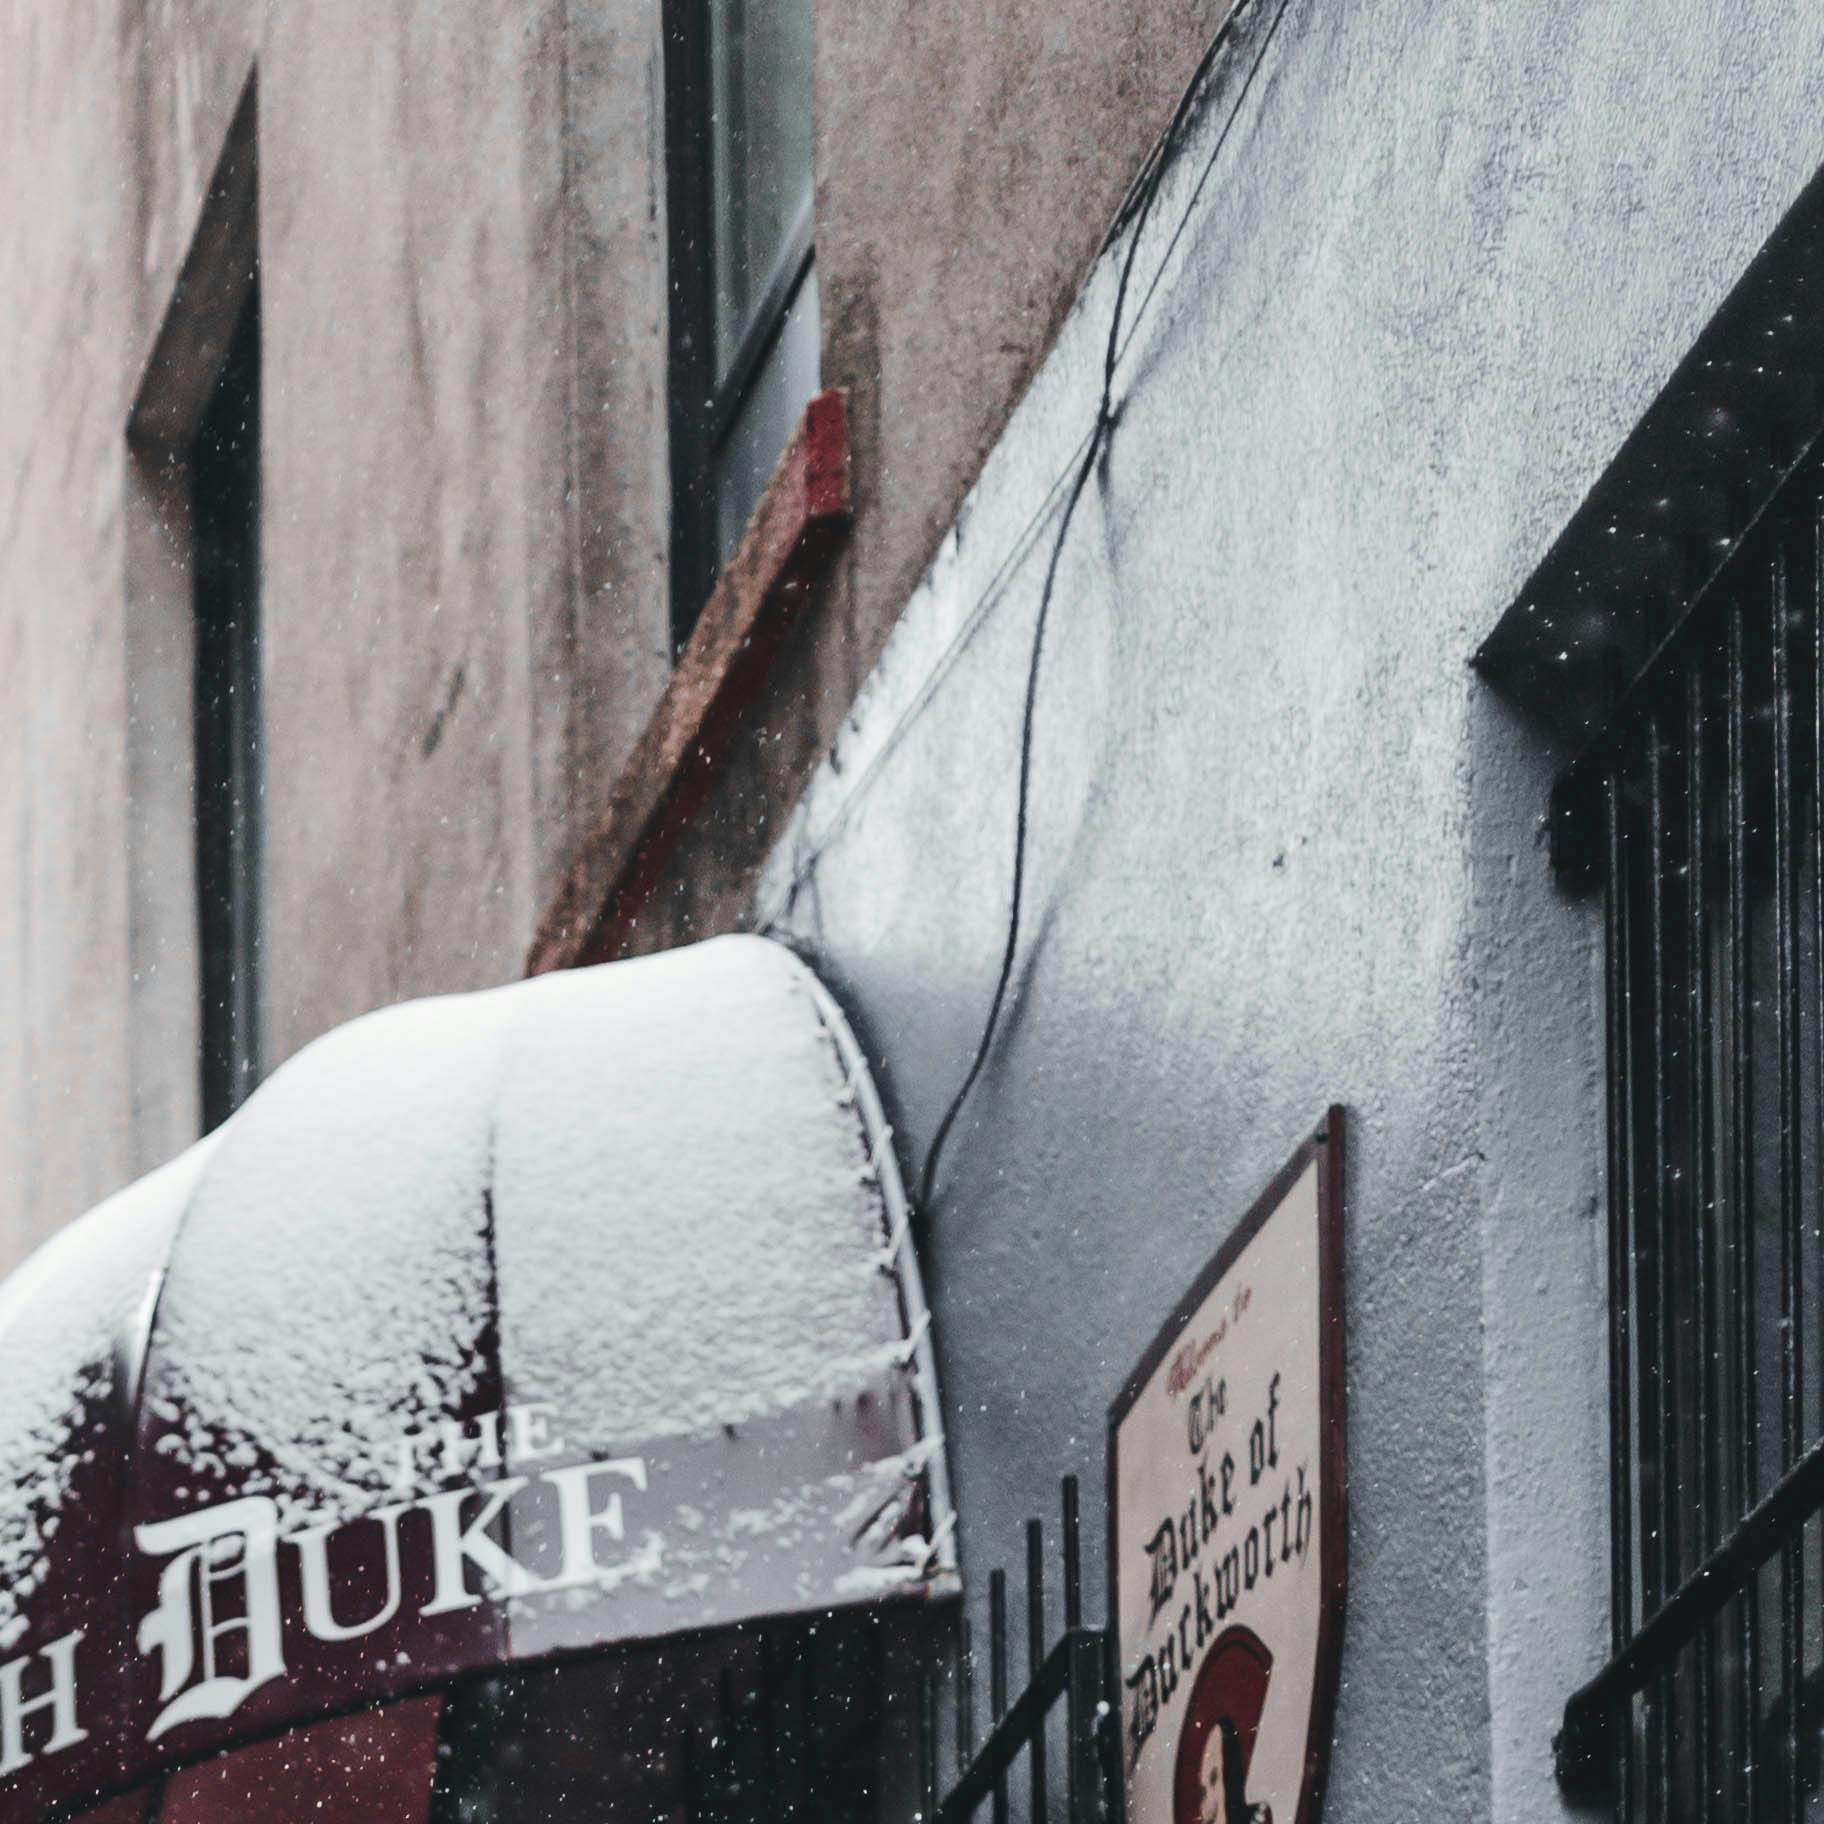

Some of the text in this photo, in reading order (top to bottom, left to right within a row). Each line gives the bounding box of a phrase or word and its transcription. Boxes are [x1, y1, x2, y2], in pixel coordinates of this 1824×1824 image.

[1143, 1371, 1281, 1631] Duke of
[1188, 1372, 1227, 1455] The
[133, 1456, 666, 1743] DUKE
[1125, 1457, 1313, 1780] Duckworth
